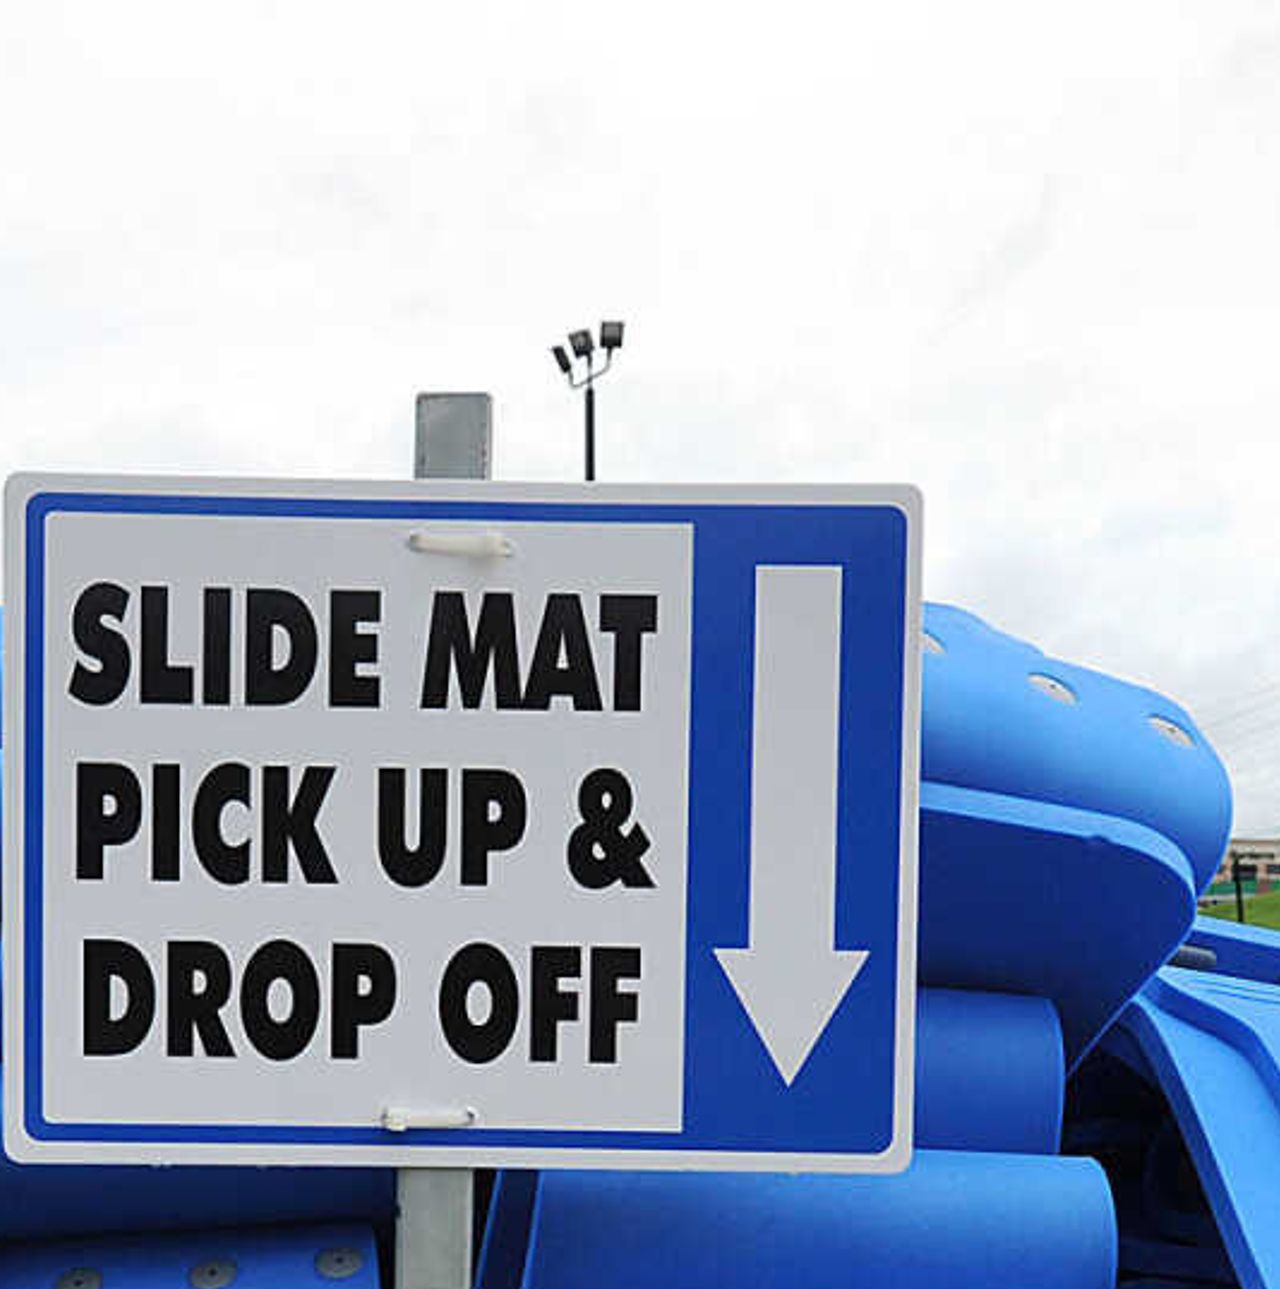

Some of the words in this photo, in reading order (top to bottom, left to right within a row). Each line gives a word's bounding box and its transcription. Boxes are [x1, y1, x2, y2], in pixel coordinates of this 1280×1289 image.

[68, 582, 382, 708] SLIDE
[419, 590, 659, 713] MAT
[75, 761, 340, 886] PICK
[377, 766, 528, 889] UP
[566, 767, 656, 890] &
[82, 937, 398, 1063] DROP
[437, 941, 642, 1066] OFF
